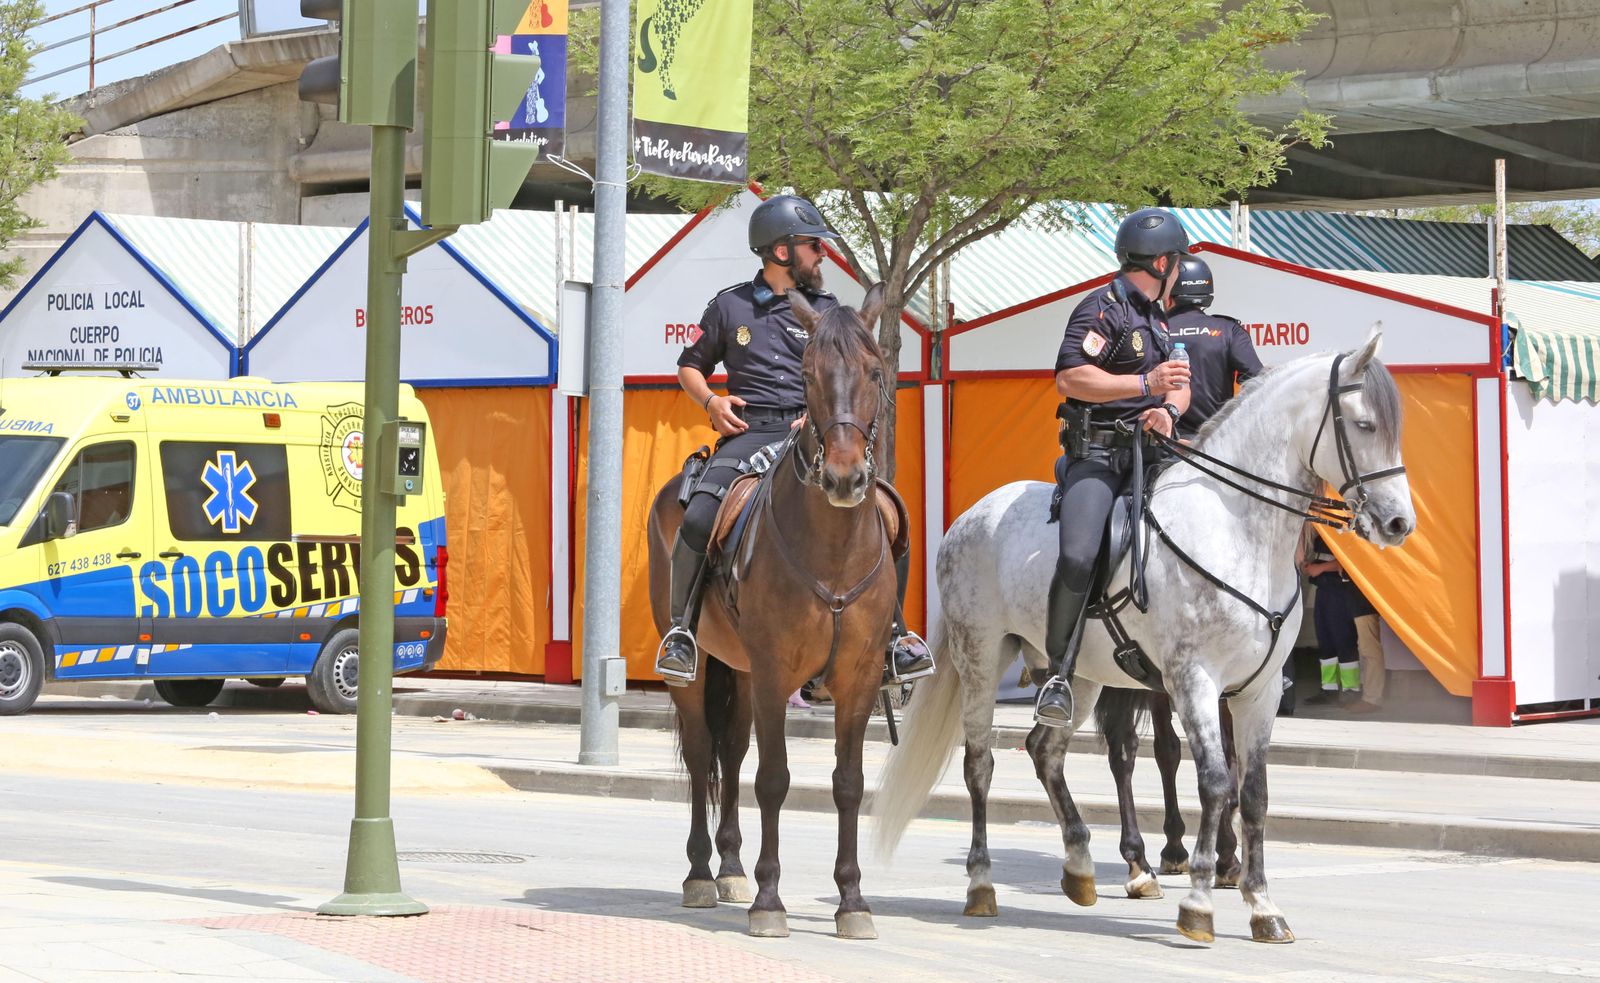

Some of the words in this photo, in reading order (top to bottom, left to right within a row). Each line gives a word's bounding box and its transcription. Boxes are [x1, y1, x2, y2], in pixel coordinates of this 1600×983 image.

[47, 293, 94, 311] POLICIA
[104, 290, 145, 309] LOCAL
[70, 326, 120, 344] CUERPO
[1169, 326, 1211, 336] LICIA
[28, 348, 85, 361] NACIONAL
[94, 347, 110, 361] DE
[127, 395, 139, 408] 37
[152, 387, 298, 408] AMBULANCIA
[48, 561, 66, 576] 627
[70, 557, 89, 571] 438
[92, 553, 111, 566] 438
[139, 527, 420, 618] SOCOSERS
